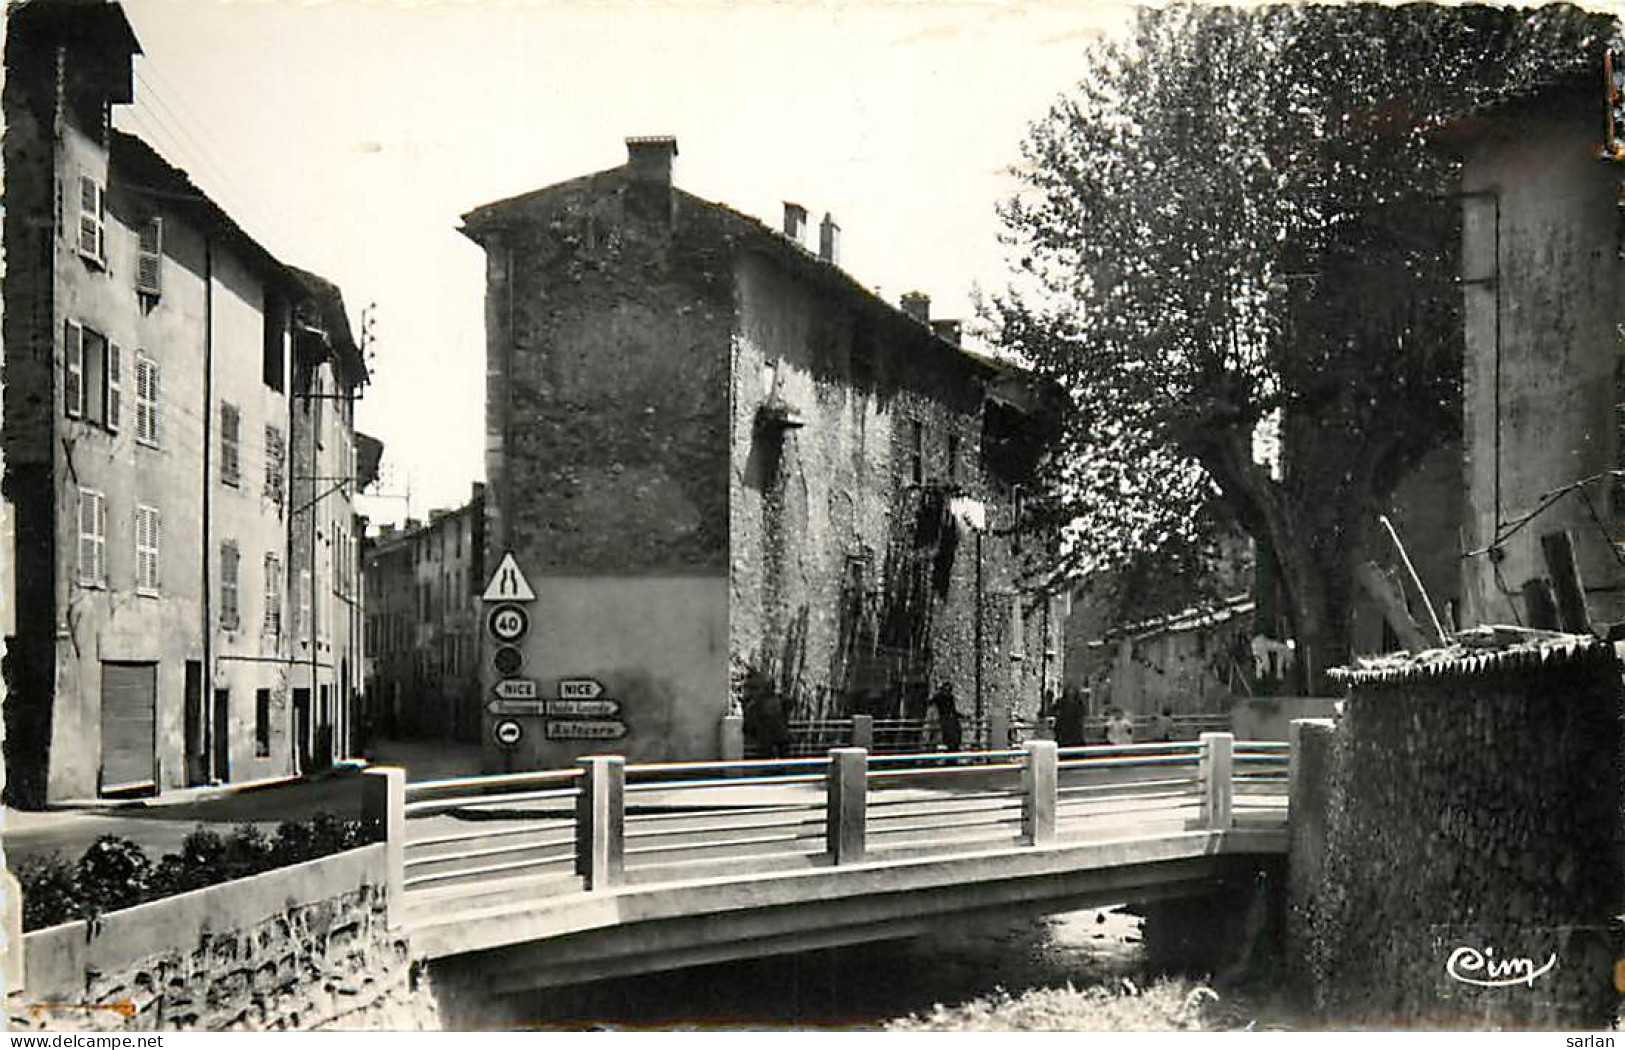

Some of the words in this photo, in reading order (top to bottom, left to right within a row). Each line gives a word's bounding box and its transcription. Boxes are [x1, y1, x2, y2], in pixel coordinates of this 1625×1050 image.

[499, 616, 519, 632] 40
[504, 684, 532, 695] NICE
[564, 684, 592, 695] NICE
